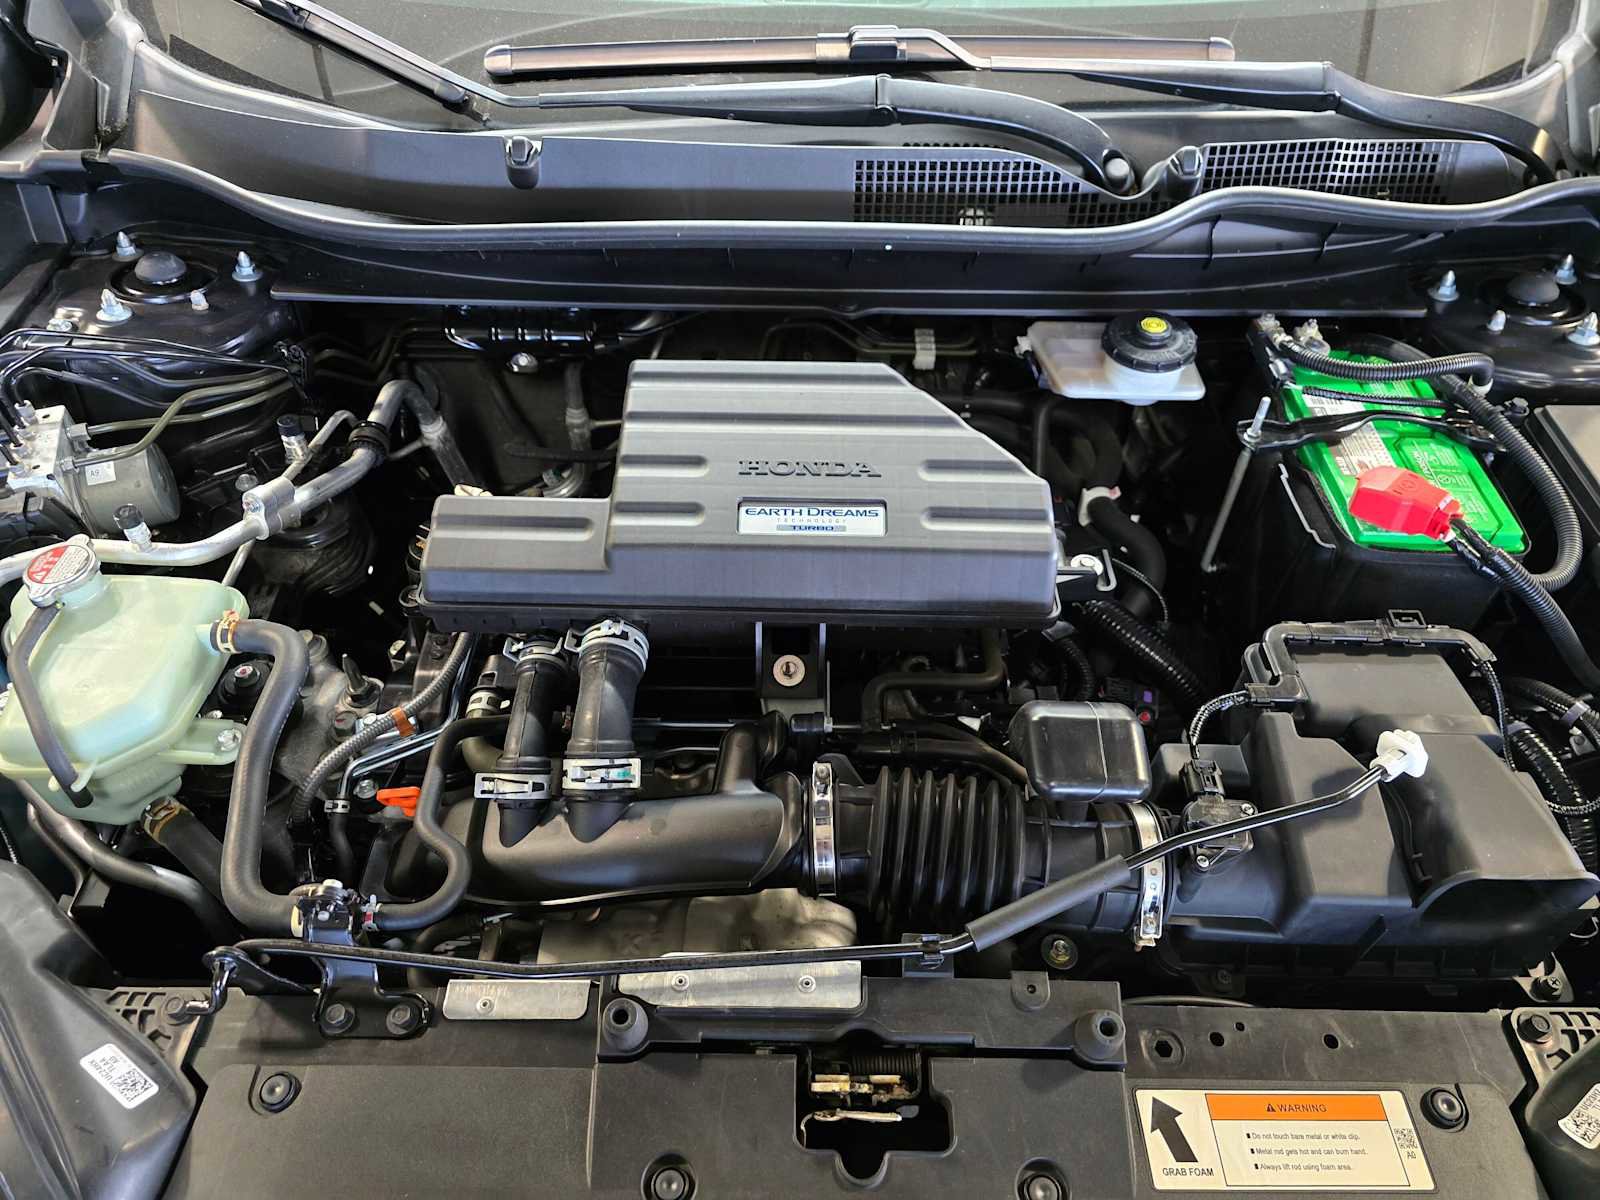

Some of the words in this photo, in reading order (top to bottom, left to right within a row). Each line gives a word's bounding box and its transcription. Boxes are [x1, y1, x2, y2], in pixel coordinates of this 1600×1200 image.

[739, 460, 881, 477] HONDA
[745, 508, 802, 516] EARTH
[807, 507, 879, 517] DREAMS
[1278, 1104, 1327, 1112] WARNING
[1162, 1168, 1187, 1176] GRAB
[1189, 1168, 1214, 1176] FOAM
[1260, 1163, 1281, 1172] Always
[1303, 1164, 1319, 1172] using
